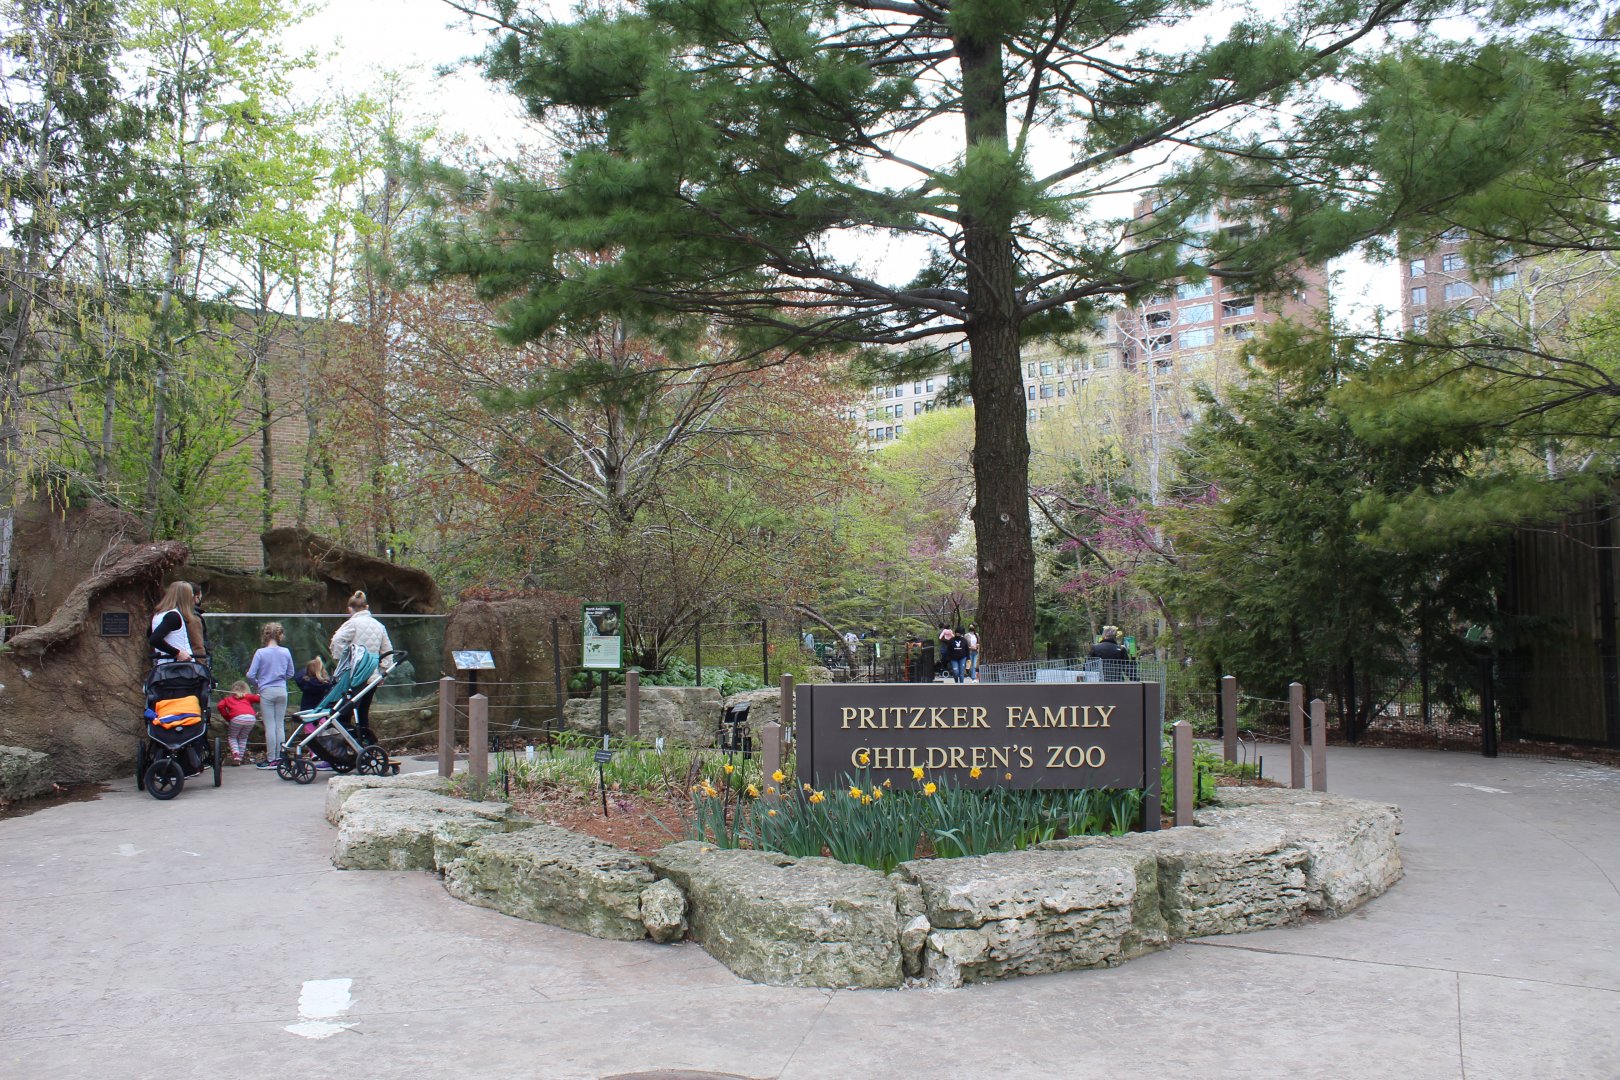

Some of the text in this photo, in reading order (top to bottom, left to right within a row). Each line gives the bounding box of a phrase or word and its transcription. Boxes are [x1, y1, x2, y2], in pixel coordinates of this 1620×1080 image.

[840, 705, 1116, 729] PRITZKER FAMILY
[851, 744, 1106, 769] CHILDREN’S ZOO
